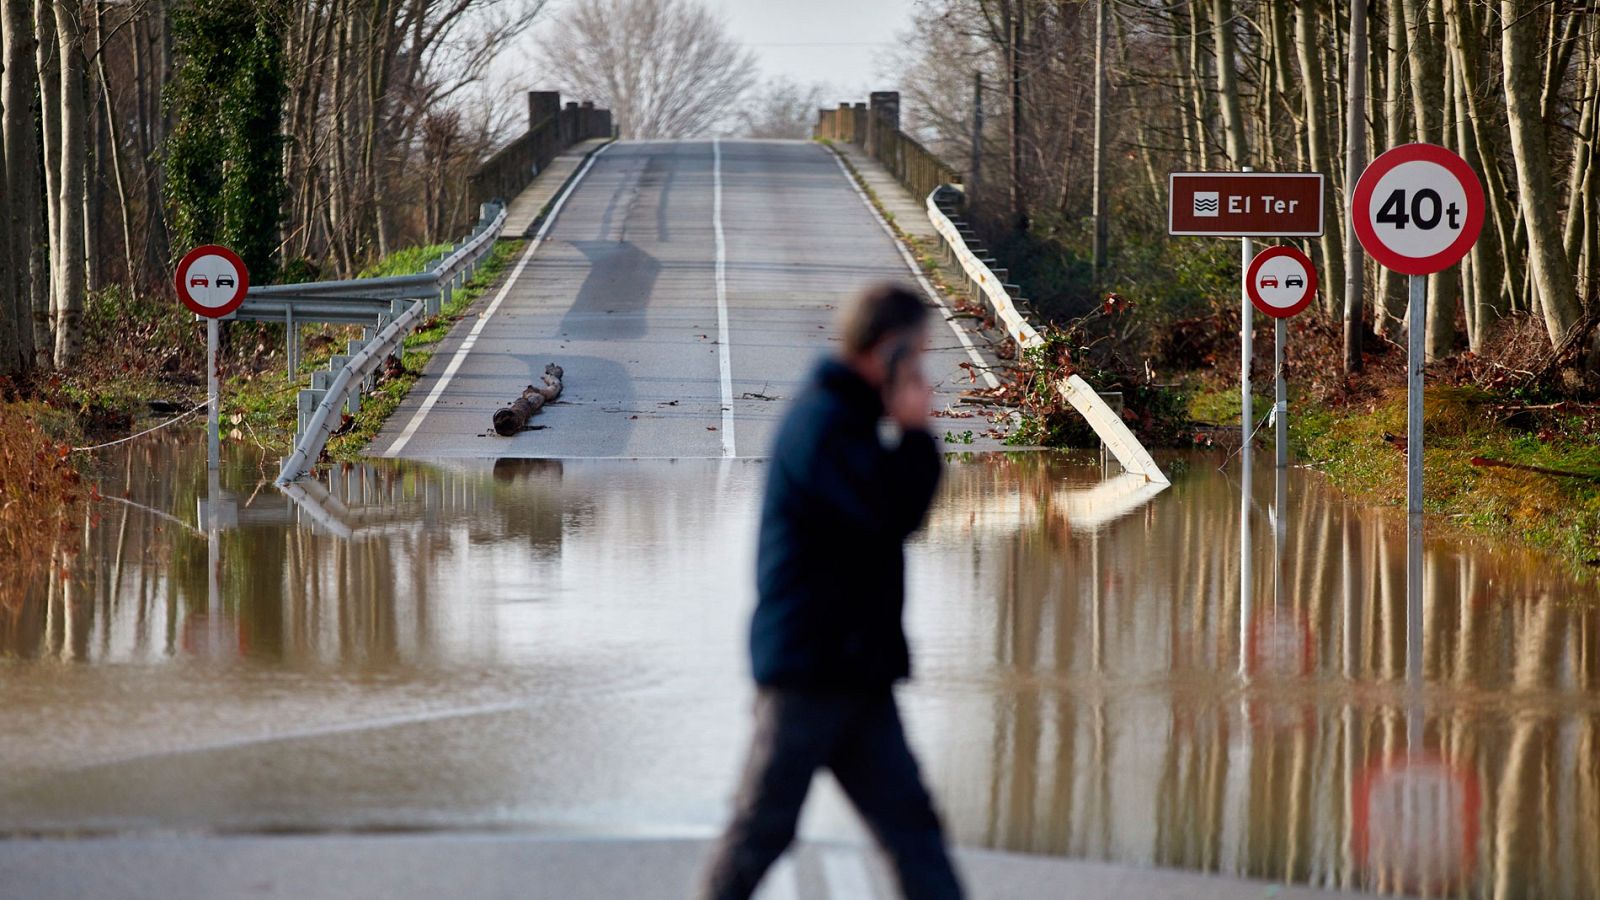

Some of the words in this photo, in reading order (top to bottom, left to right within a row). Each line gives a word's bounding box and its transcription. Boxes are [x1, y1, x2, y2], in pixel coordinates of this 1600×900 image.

[1228, 196, 1250, 213] El
[1261, 196, 1298, 213] Ter
[1376, 188, 1460, 230] 40t
